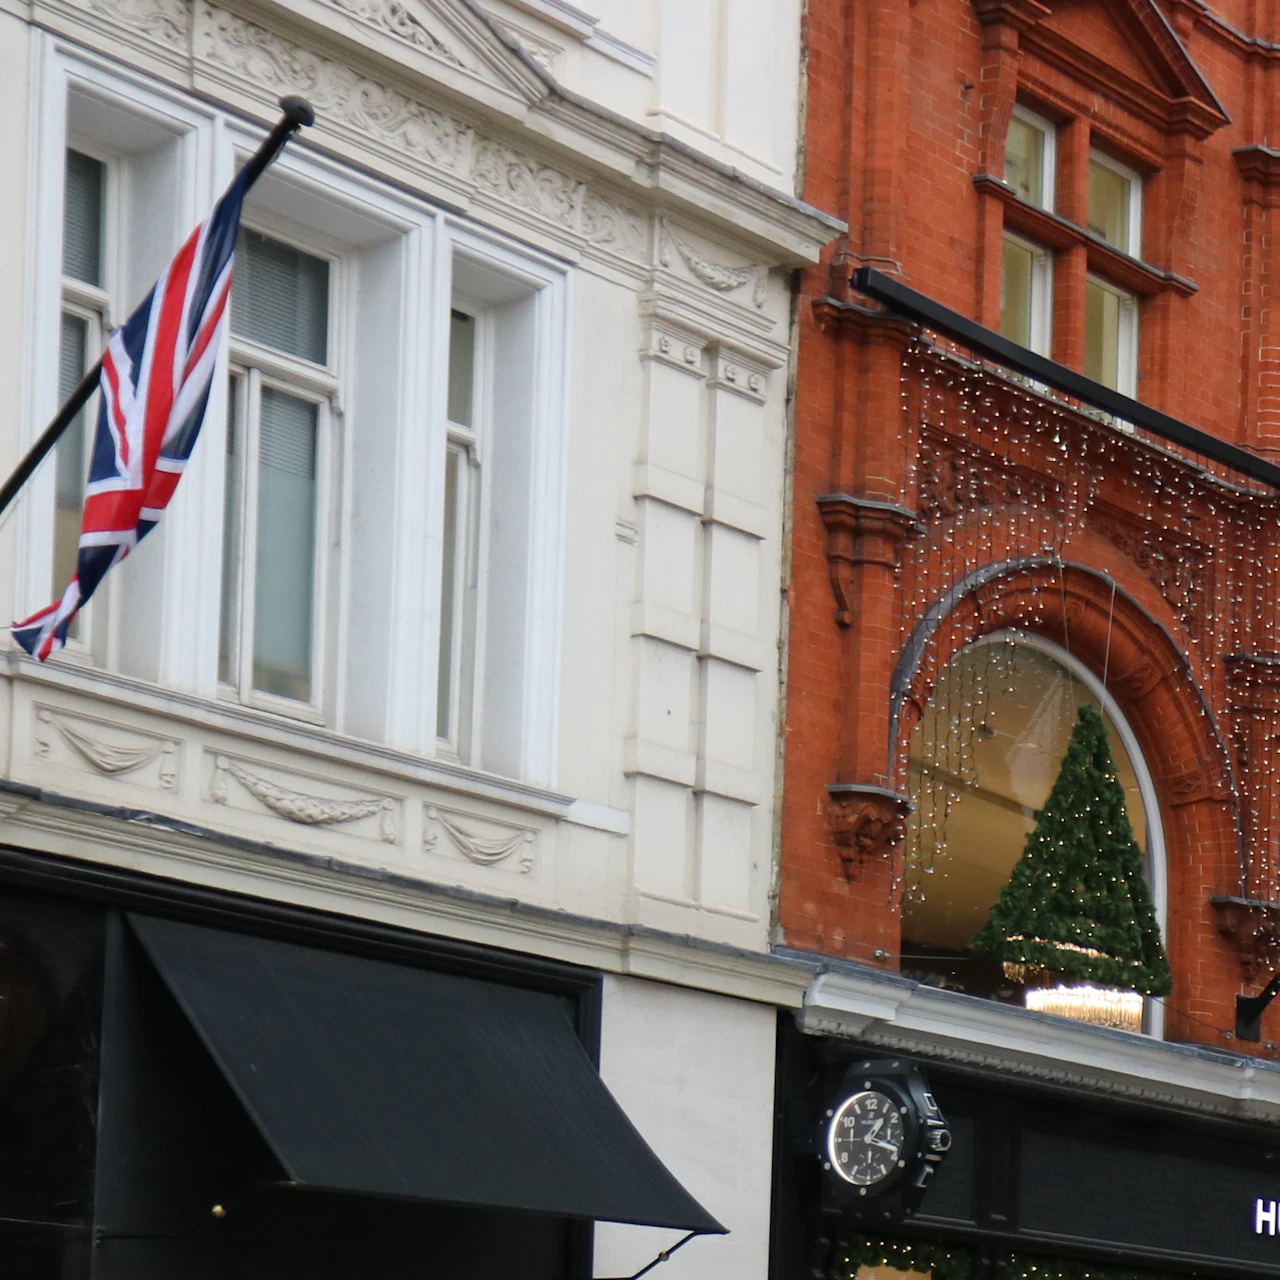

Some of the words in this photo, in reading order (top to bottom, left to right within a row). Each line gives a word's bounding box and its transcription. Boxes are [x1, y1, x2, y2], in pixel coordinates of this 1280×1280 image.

[865, 1099, 878, 1110] 12
[842, 1117, 855, 1128] 10
[890, 1113, 898, 1123] 2
[841, 1152, 848, 1162] 8
